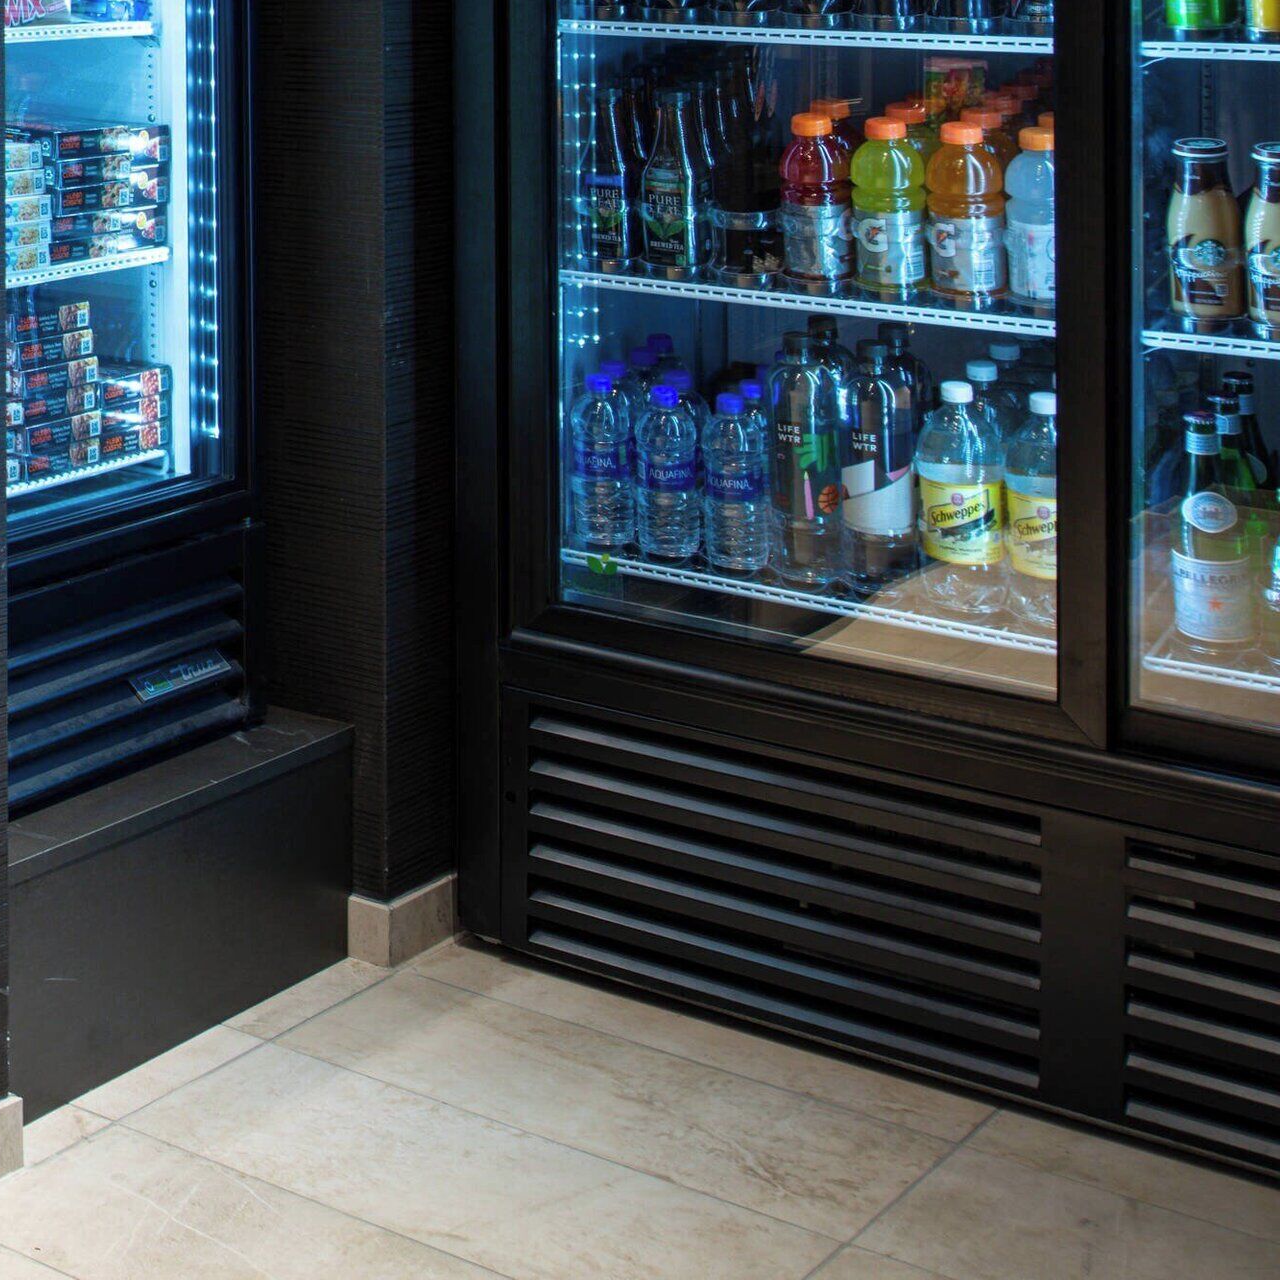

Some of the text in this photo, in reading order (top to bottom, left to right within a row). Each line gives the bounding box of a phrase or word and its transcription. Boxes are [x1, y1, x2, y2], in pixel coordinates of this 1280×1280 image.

[648, 194, 681, 206] PURE
[674, 242, 684, 251] TEA
[777, 423, 801, 434] LIFE
[778, 433, 801, 444] WTR
[852, 431, 877, 443] LIFE
[853, 441, 878, 453] WTR
